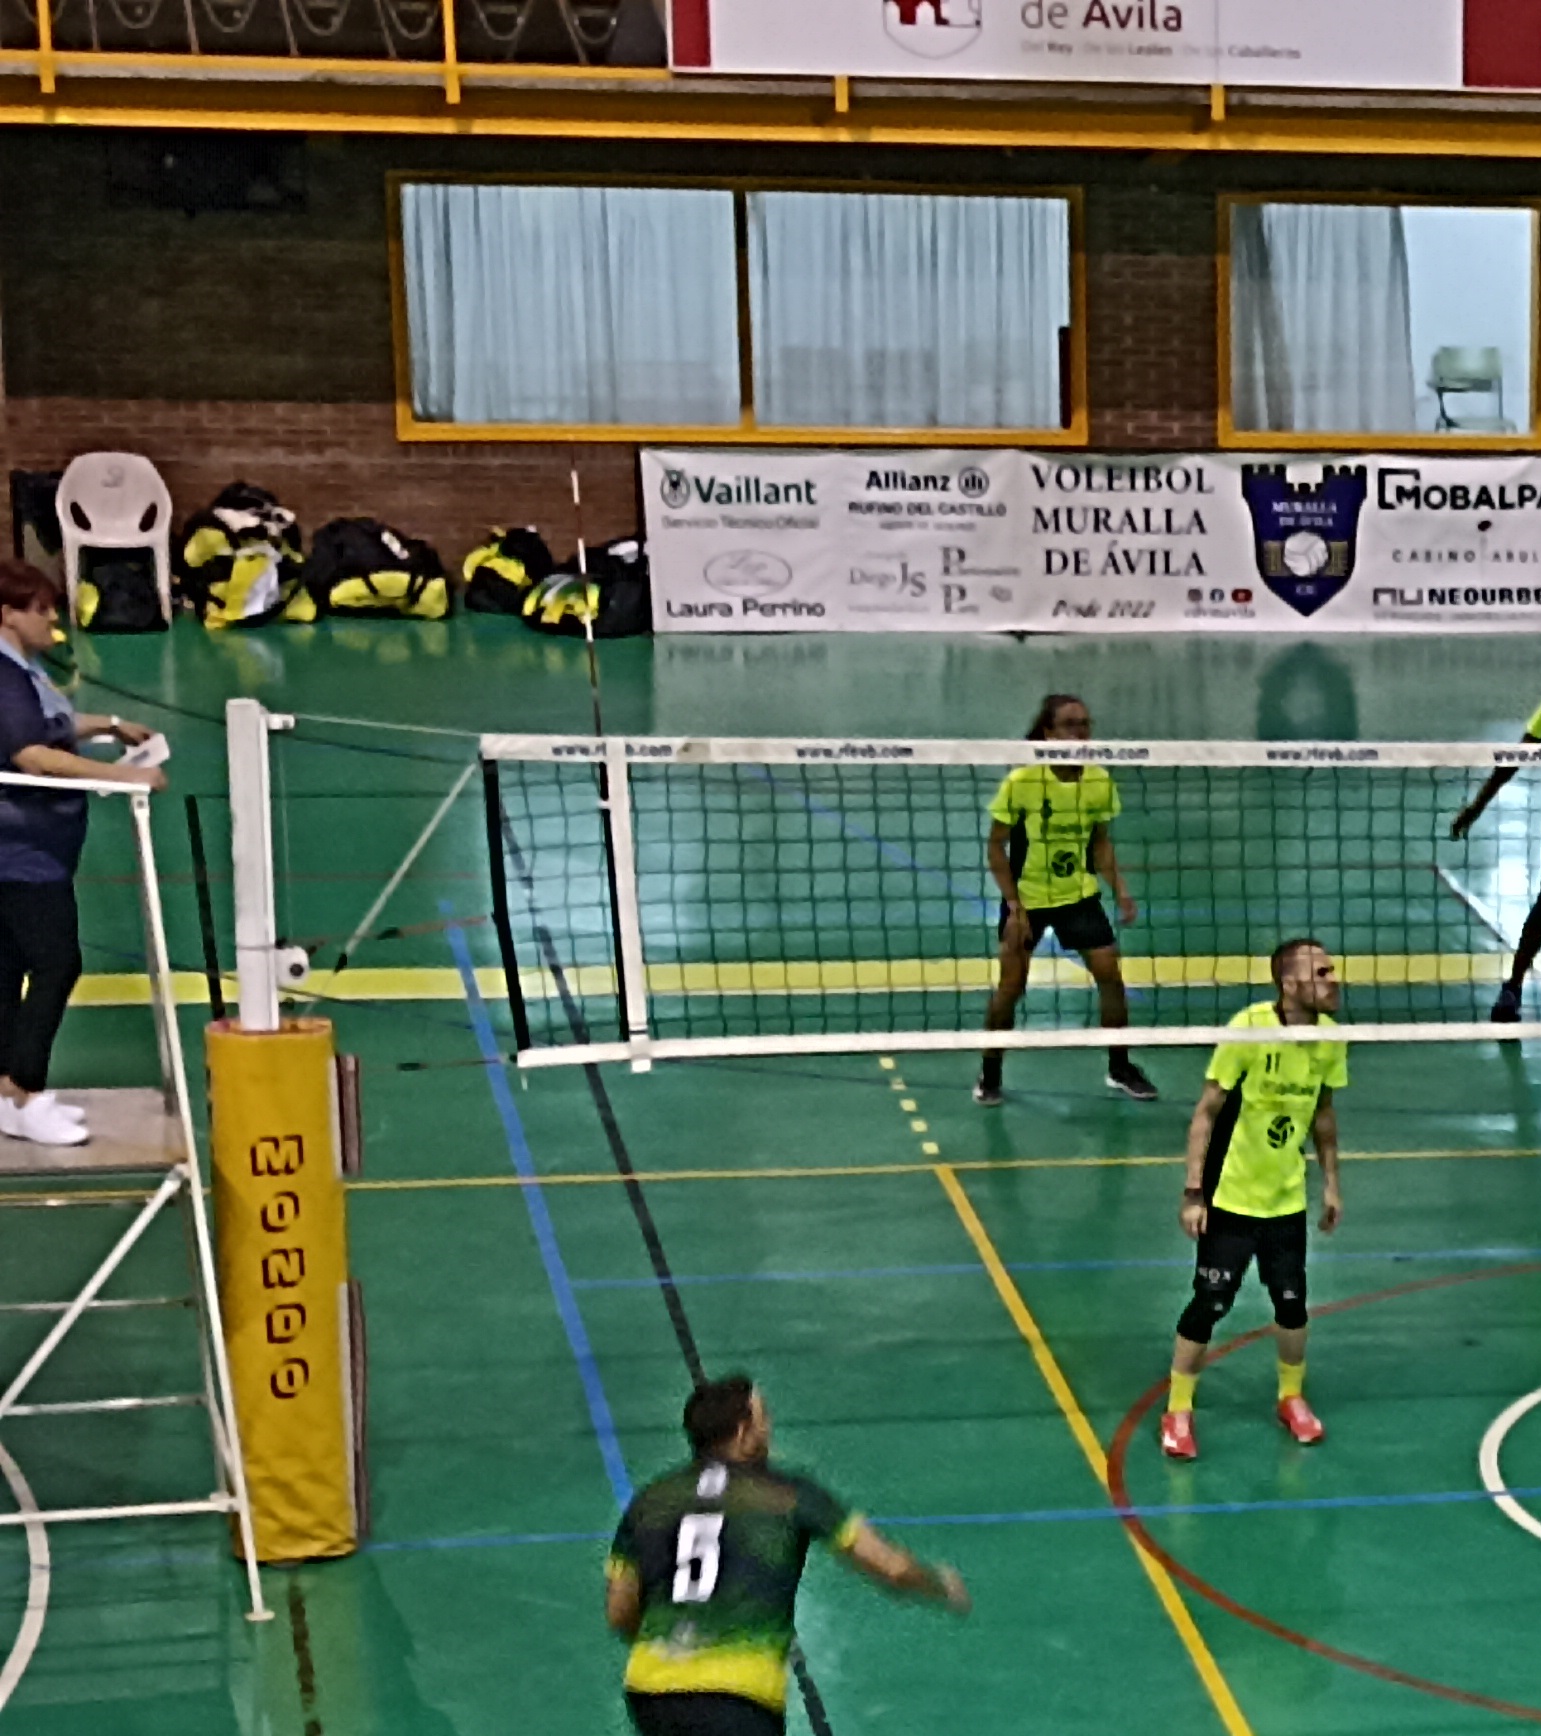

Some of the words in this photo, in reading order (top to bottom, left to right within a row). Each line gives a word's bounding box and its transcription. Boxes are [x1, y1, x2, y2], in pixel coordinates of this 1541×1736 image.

[1021, 0, 1068, 29] de
[694, 476, 817, 506] Vaillant
[865, 469, 950, 492] Allianz
[1031, 465, 1214, 494] VOLEIBOL
[938, 502, 1007, 517] CASTILLO
[1032, 507, 1208, 535] MURALLA
[1044, 549, 1092, 576] DE
[1102, 540, 1207, 576] ÁVILA
[666, 600, 733, 618] Laura
[742, 600, 825, 618] Perrino
[250, 1134, 309, 1400] MONDO
